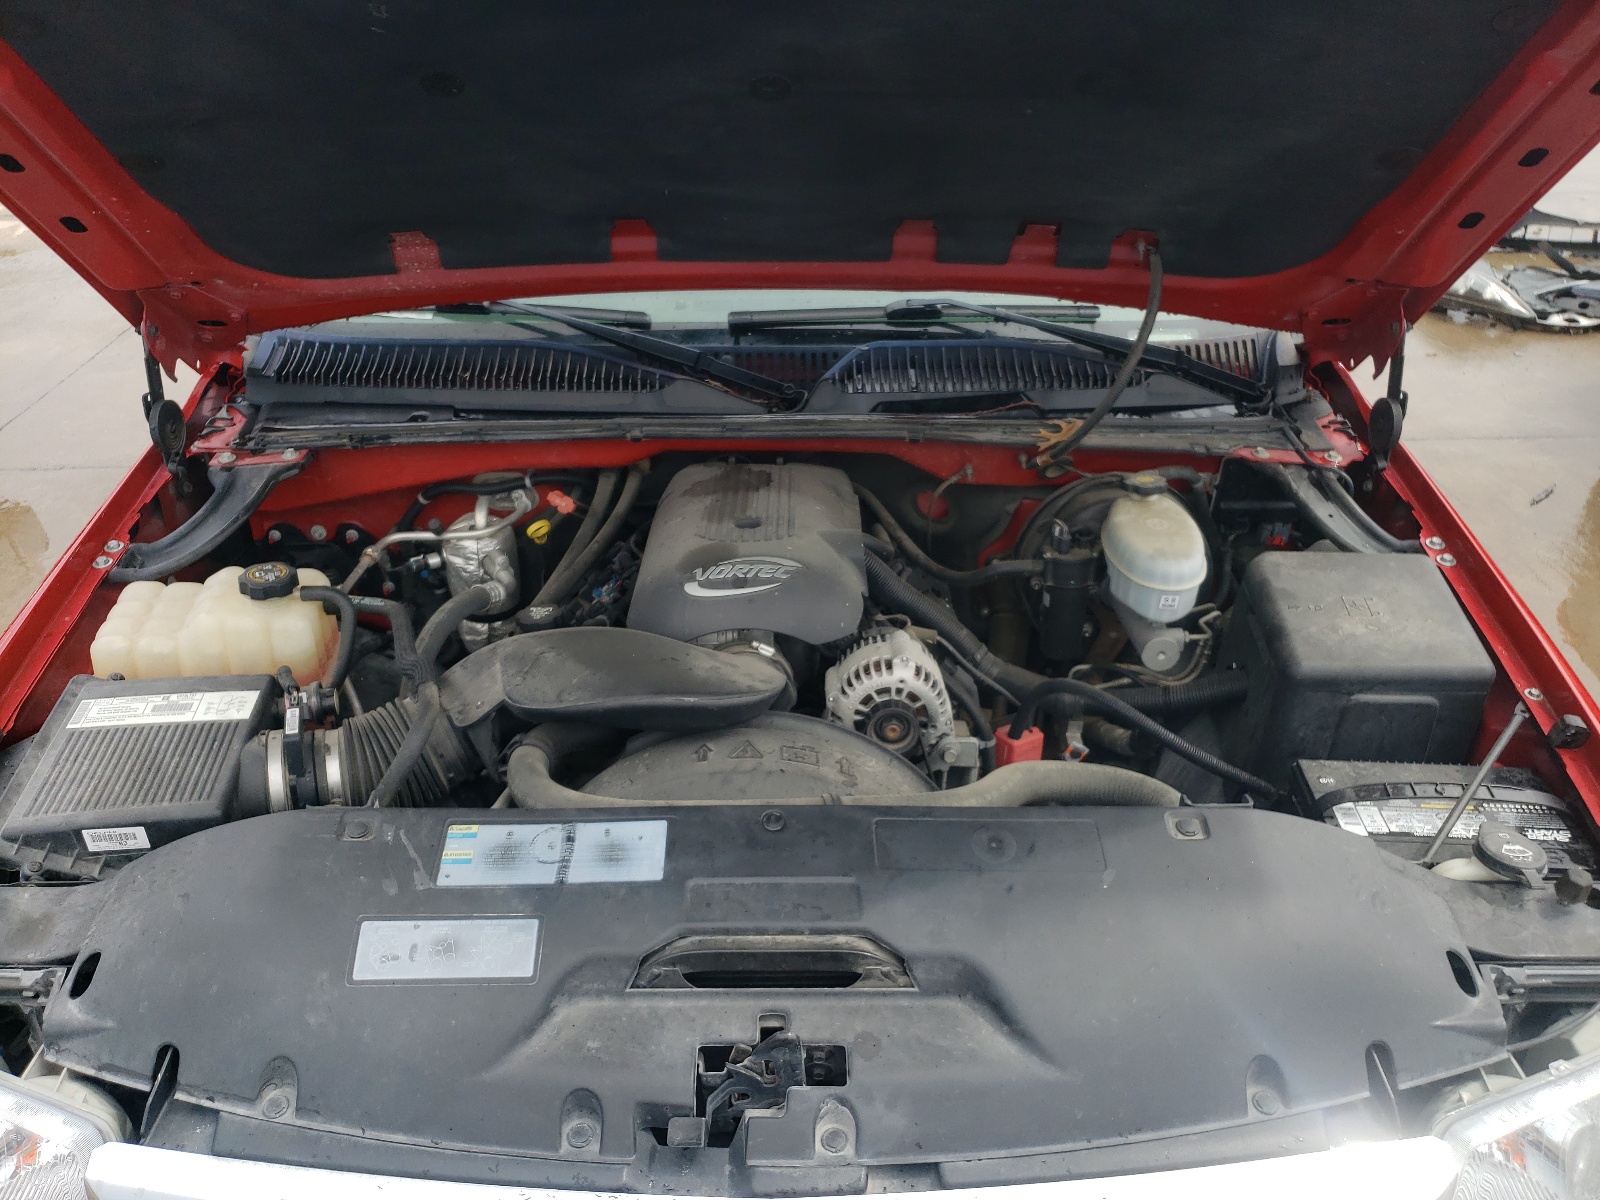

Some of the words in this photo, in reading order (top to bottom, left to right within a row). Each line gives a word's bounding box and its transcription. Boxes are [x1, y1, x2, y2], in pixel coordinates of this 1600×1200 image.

[692, 564, 798, 581] VORTEC
[1522, 827, 1572, 837] START
[1527, 832, 1571, 843] SUPER
